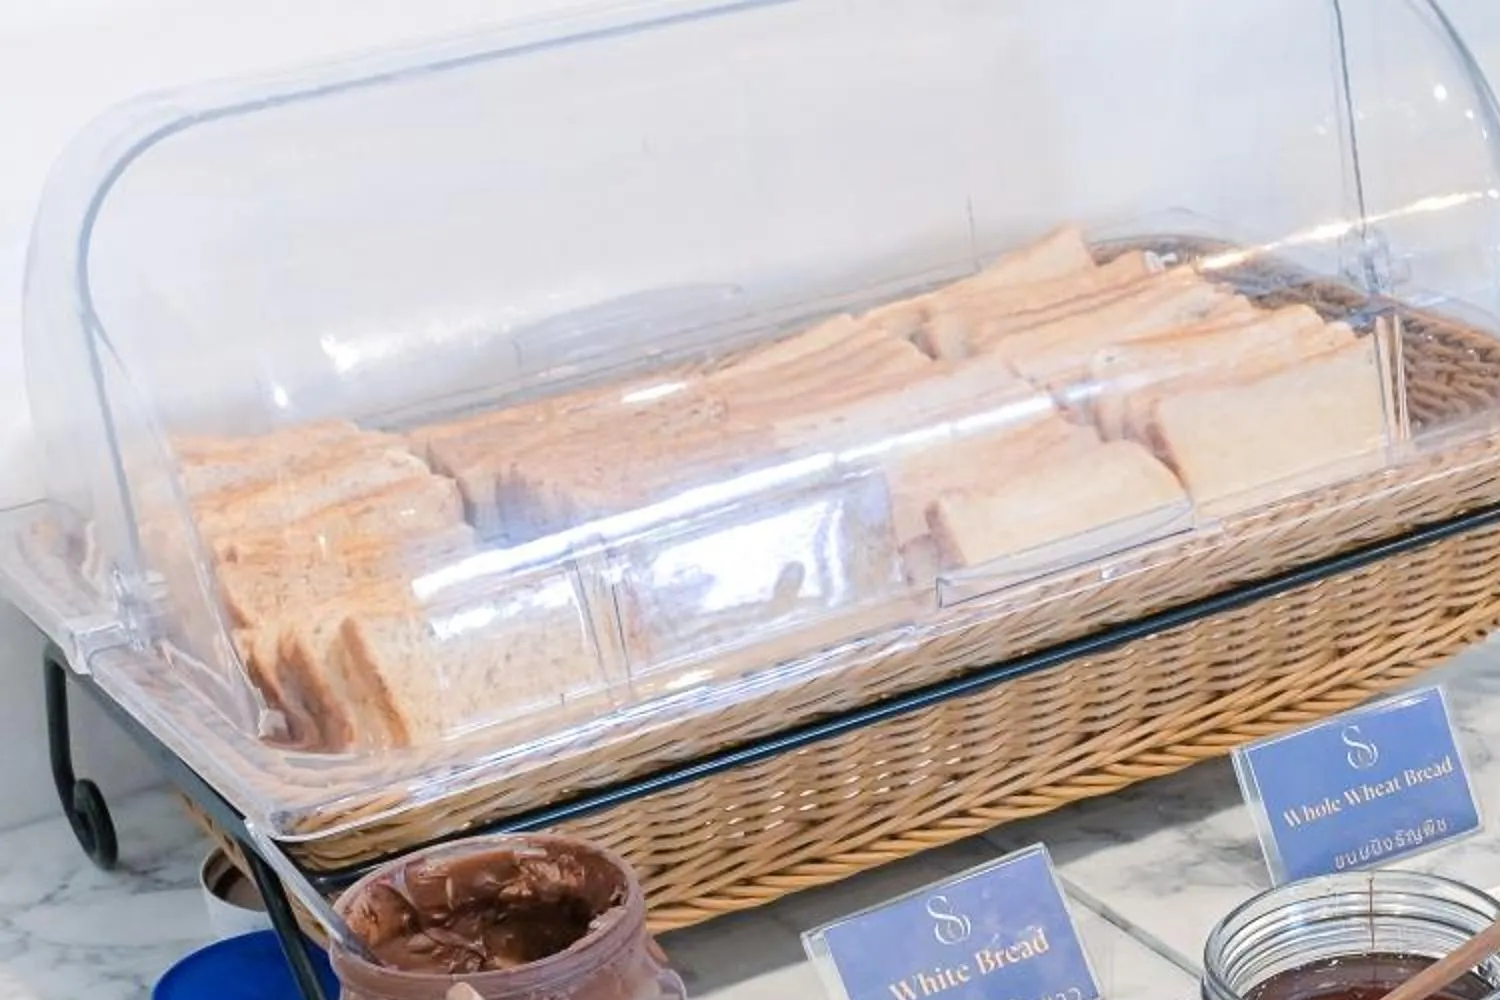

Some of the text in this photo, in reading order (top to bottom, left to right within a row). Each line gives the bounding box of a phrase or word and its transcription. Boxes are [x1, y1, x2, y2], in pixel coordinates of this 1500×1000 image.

[1283, 755, 1454, 828] Whole Wheat Bread
[974, 926, 1050, 975] Bread
